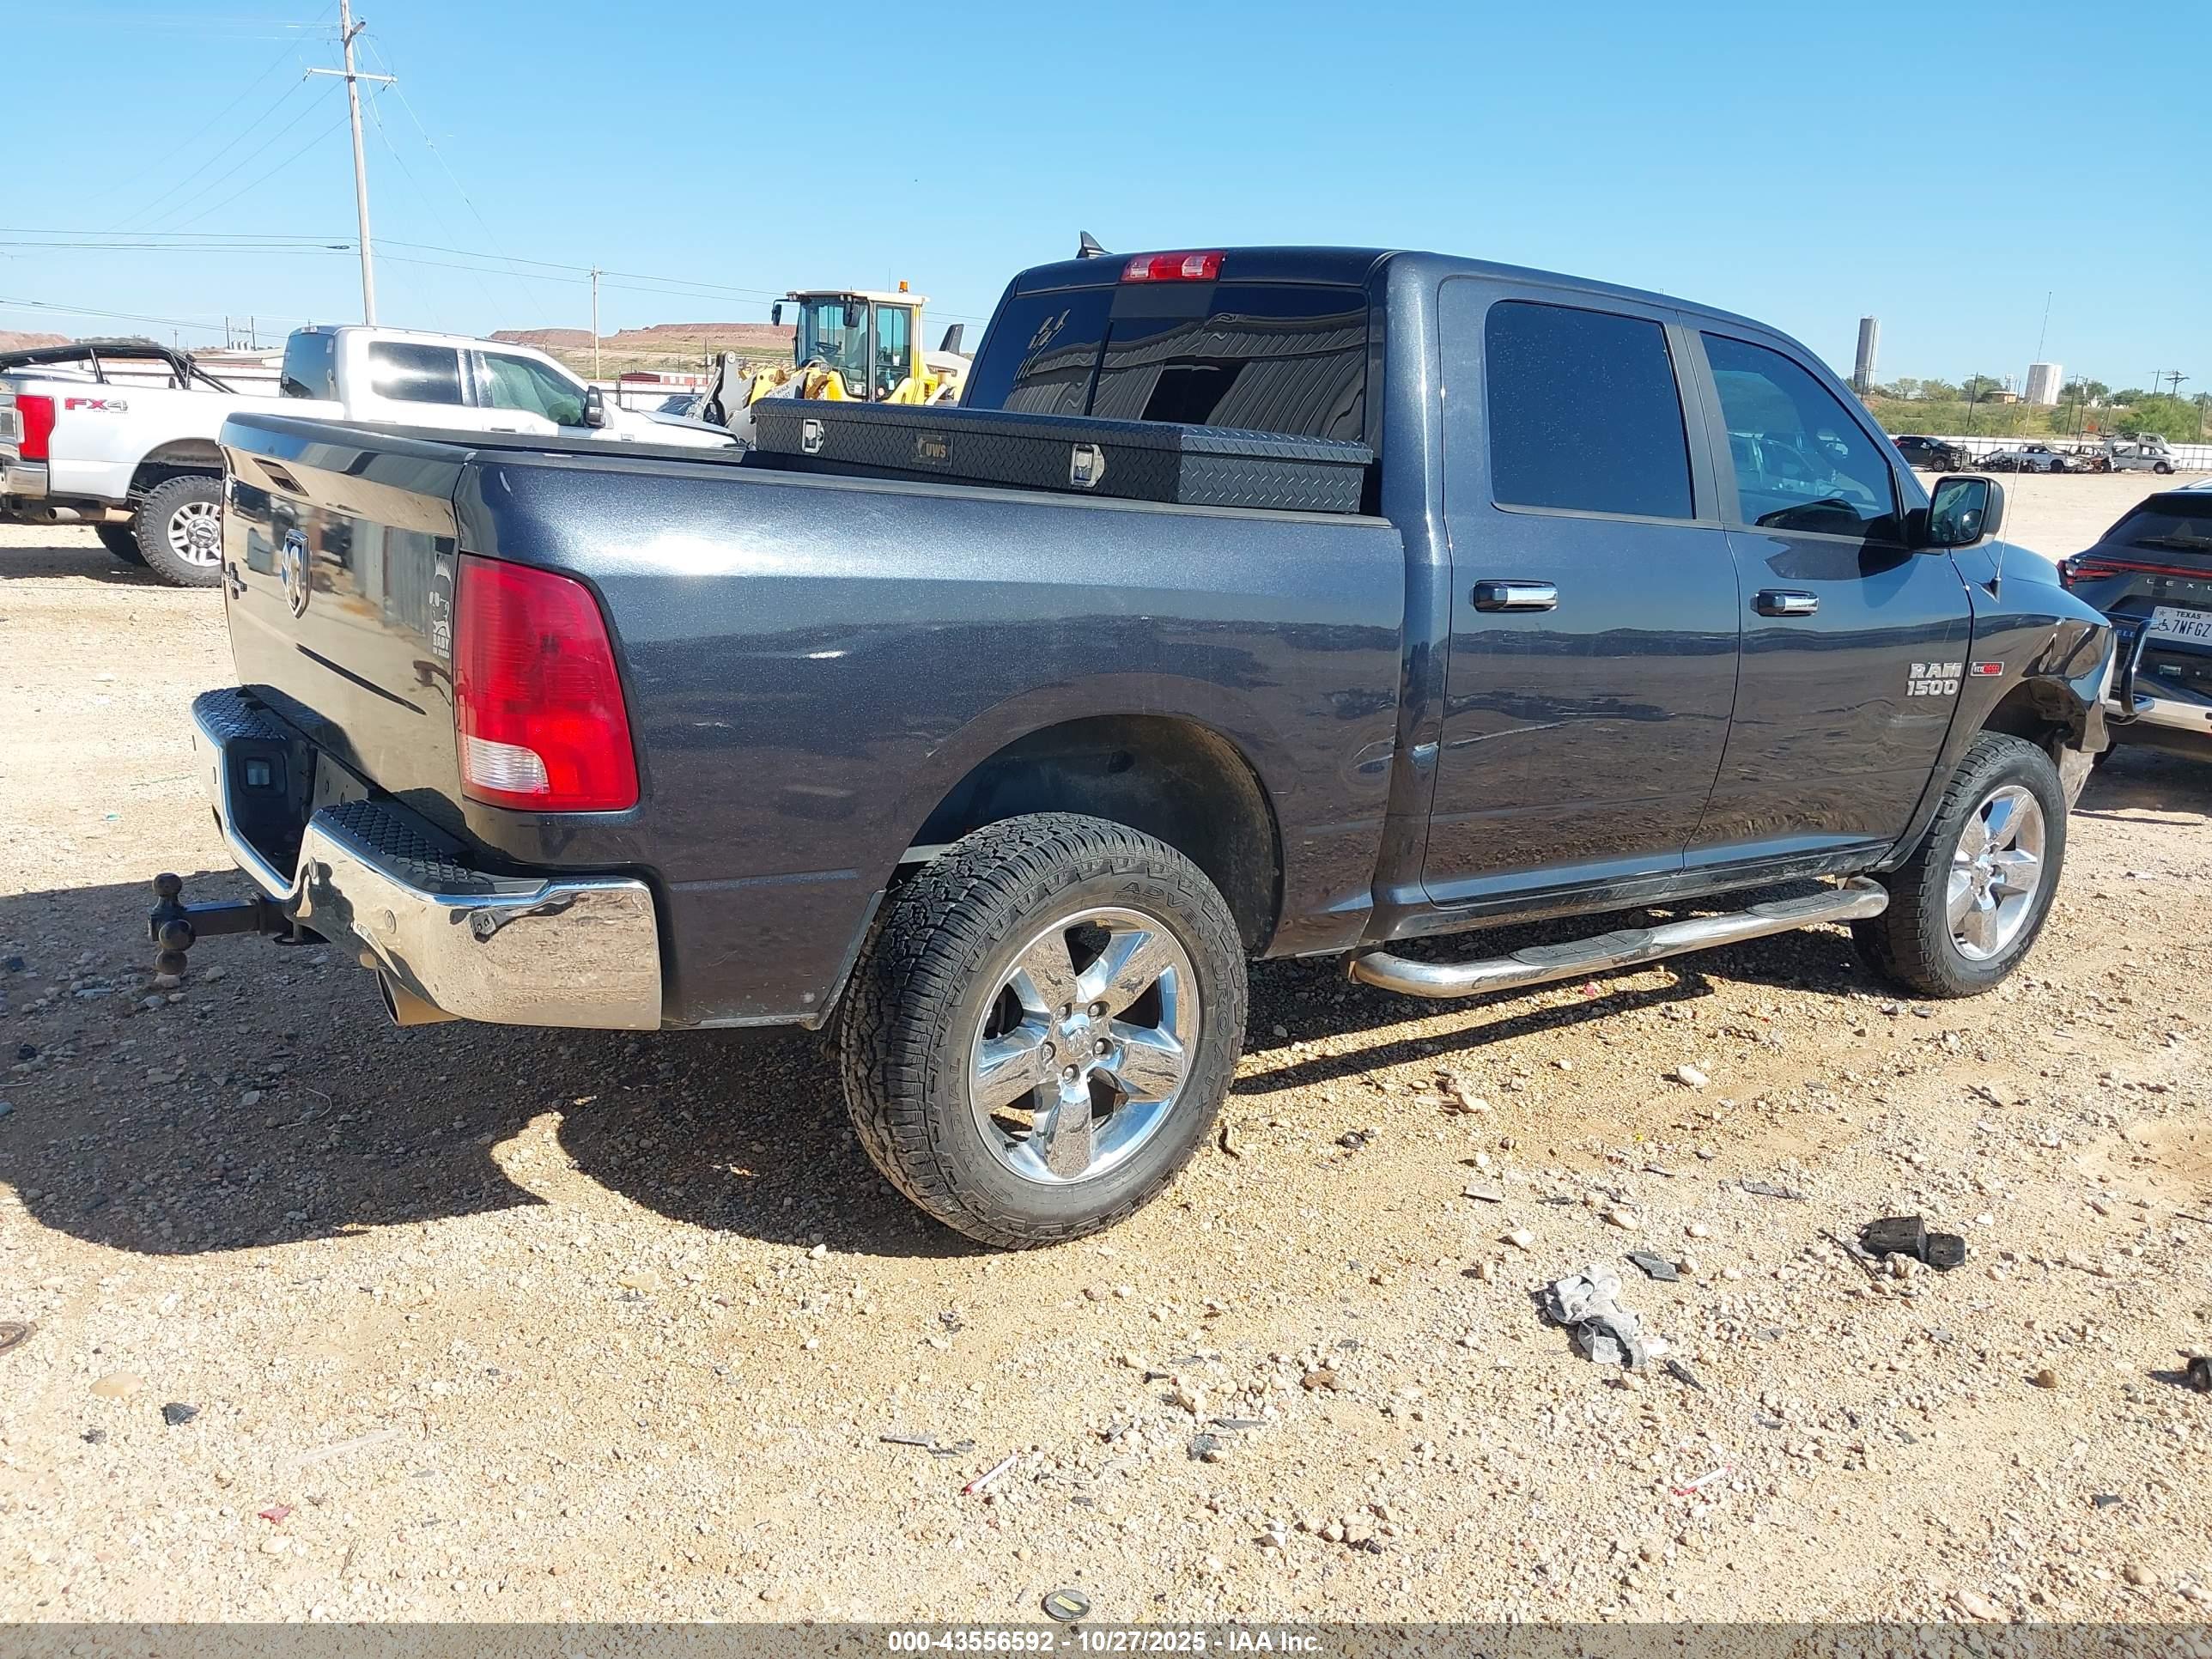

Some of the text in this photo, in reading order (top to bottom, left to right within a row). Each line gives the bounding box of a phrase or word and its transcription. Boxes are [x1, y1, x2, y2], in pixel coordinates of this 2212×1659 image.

[64, 398, 128, 411] FX4
[926, 442, 946, 459] UWS
[2176, 611, 2202, 619] TEXAS
[1909, 662, 1963, 679] RAM
[1905, 679, 1959, 696] 1500
